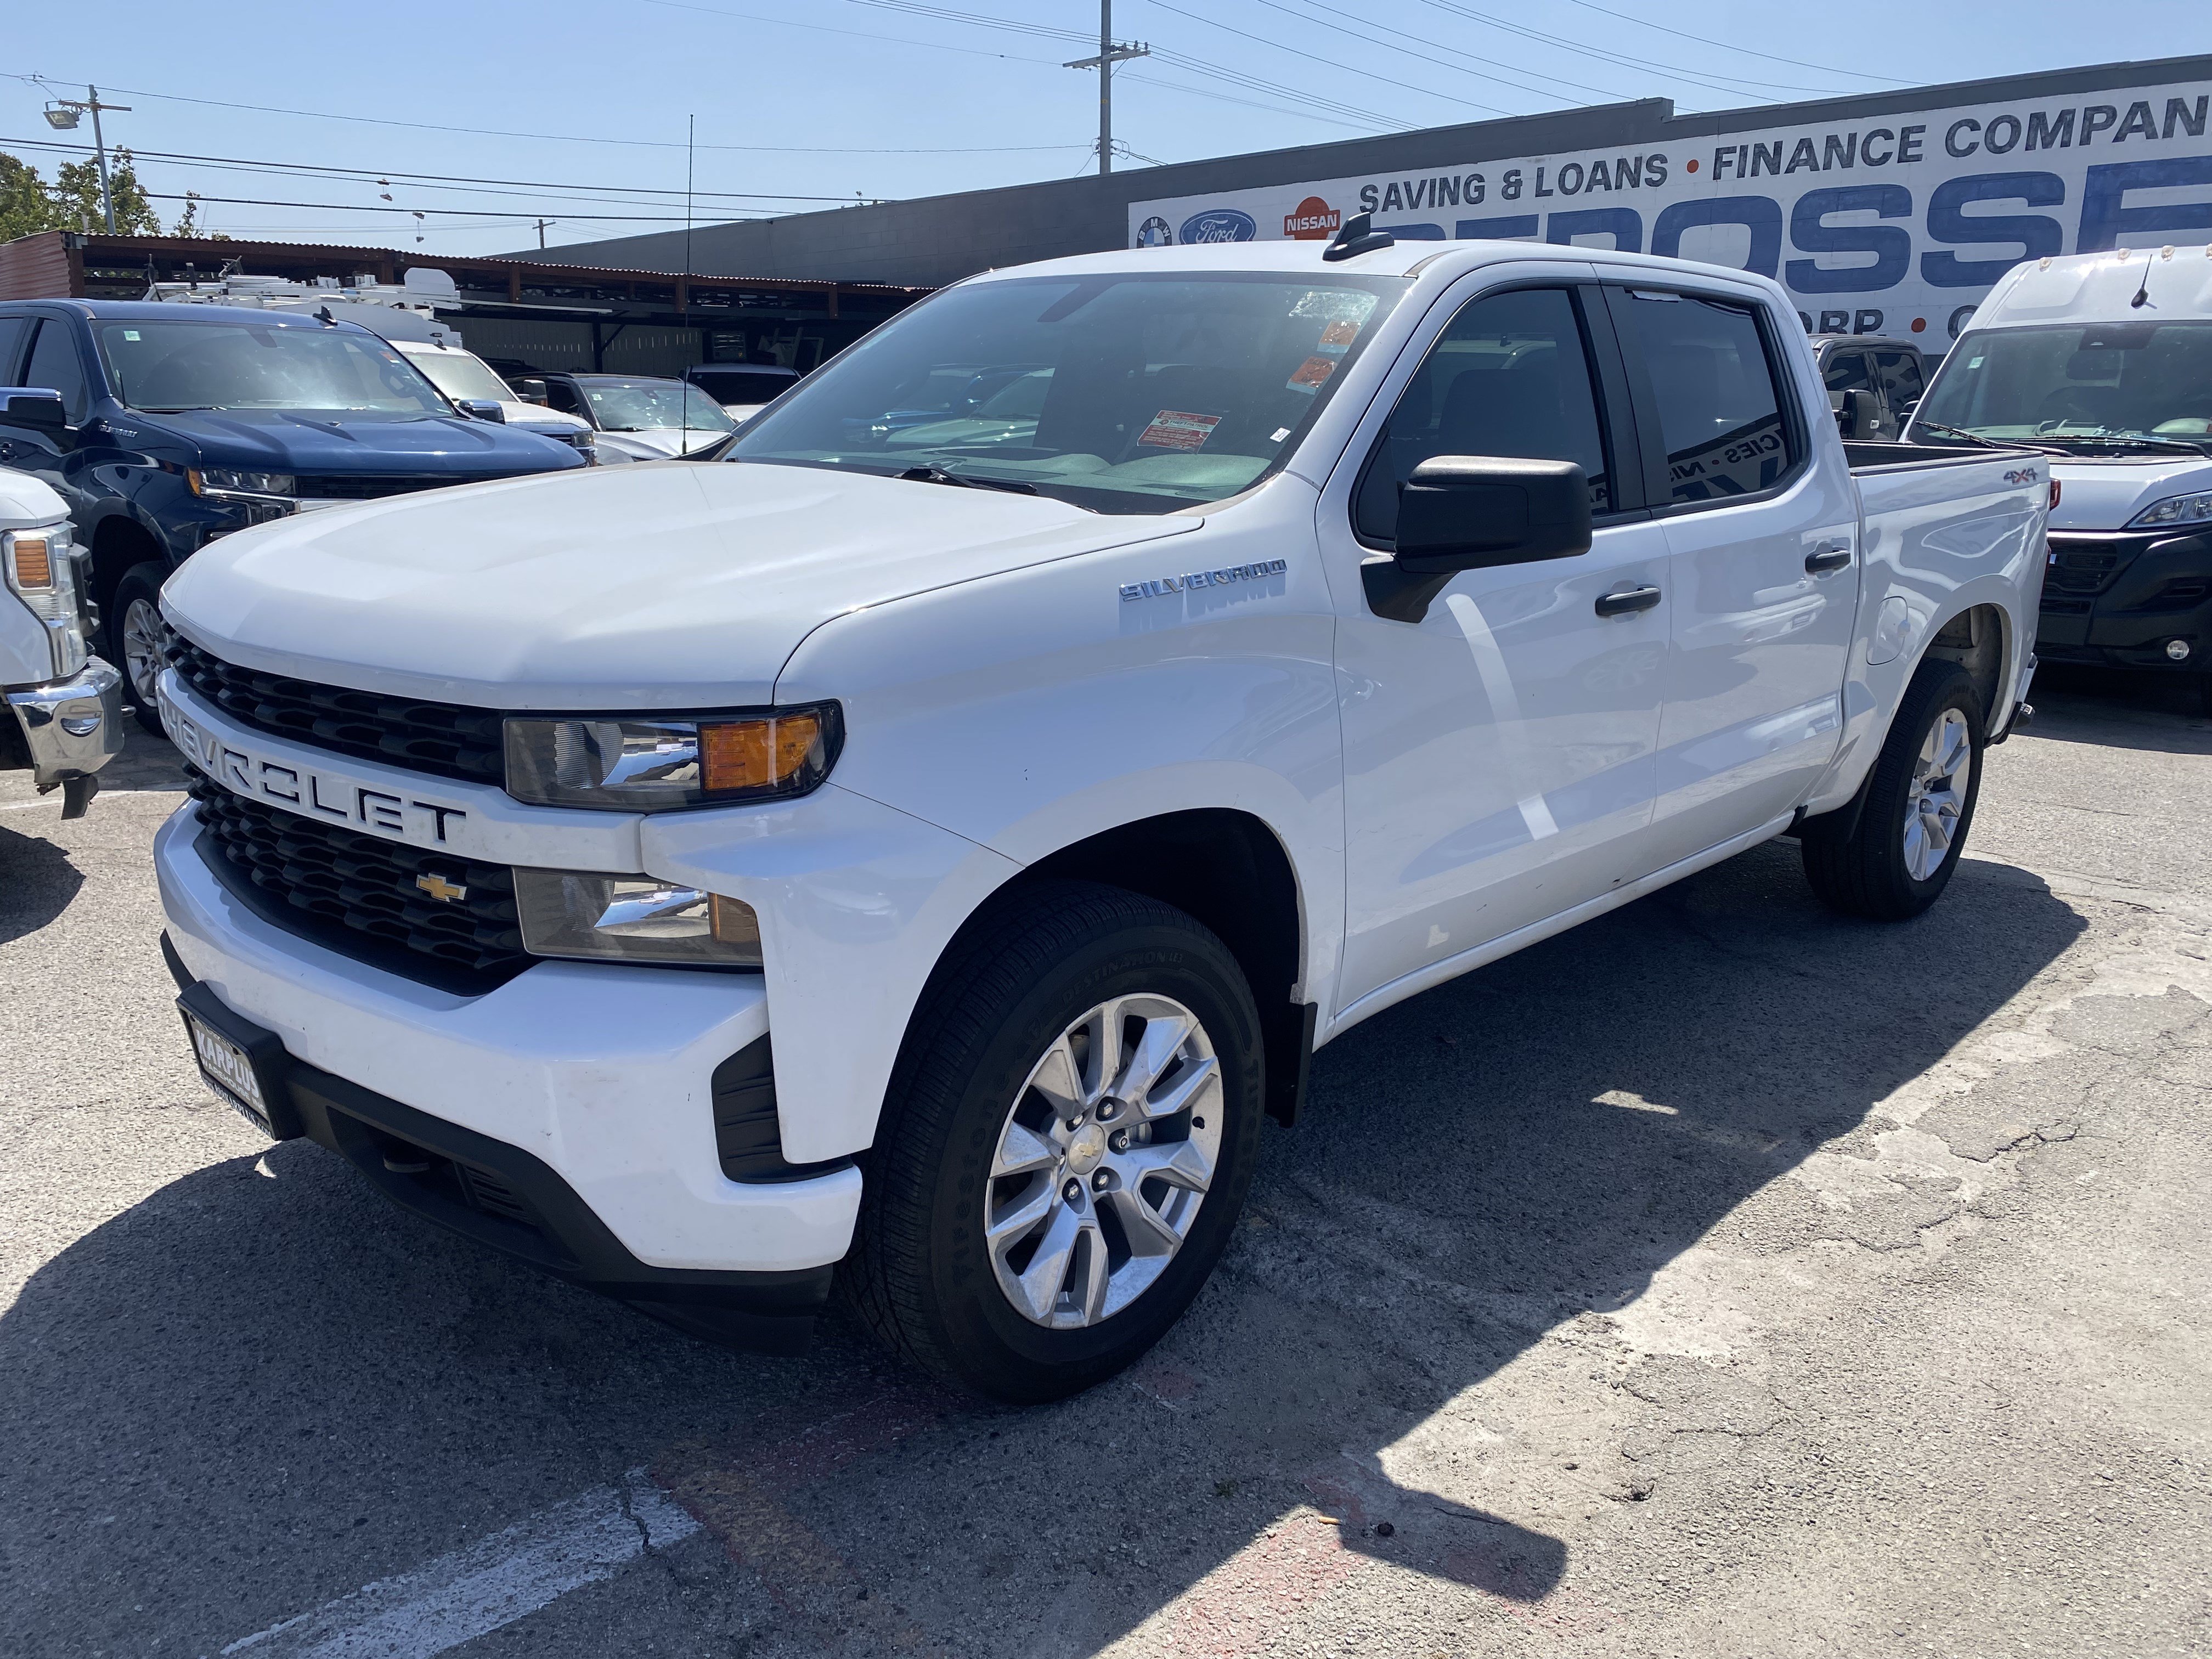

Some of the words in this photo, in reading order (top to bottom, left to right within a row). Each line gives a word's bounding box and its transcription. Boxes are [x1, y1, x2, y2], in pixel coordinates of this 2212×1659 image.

[1359, 173, 1485, 214] SAVING
[1502, 169, 1523, 201] &
[1536, 153, 1668, 198] LOANS
[1713, 125, 1927, 181] FINANCE
[1945, 95, 2212, 157] COMPAN
[1138, 218, 1171, 240] BMW
[1195, 219, 1239, 244] Ford
[1286, 213, 1338, 232] NISSAN
[1119, 558, 1288, 601] SILVERADO
[157, 695, 467, 843] CHEVROLET
[196, 1029, 259, 1098] KARPLUS
[201, 1057, 250, 1101] WAREHOUSE
